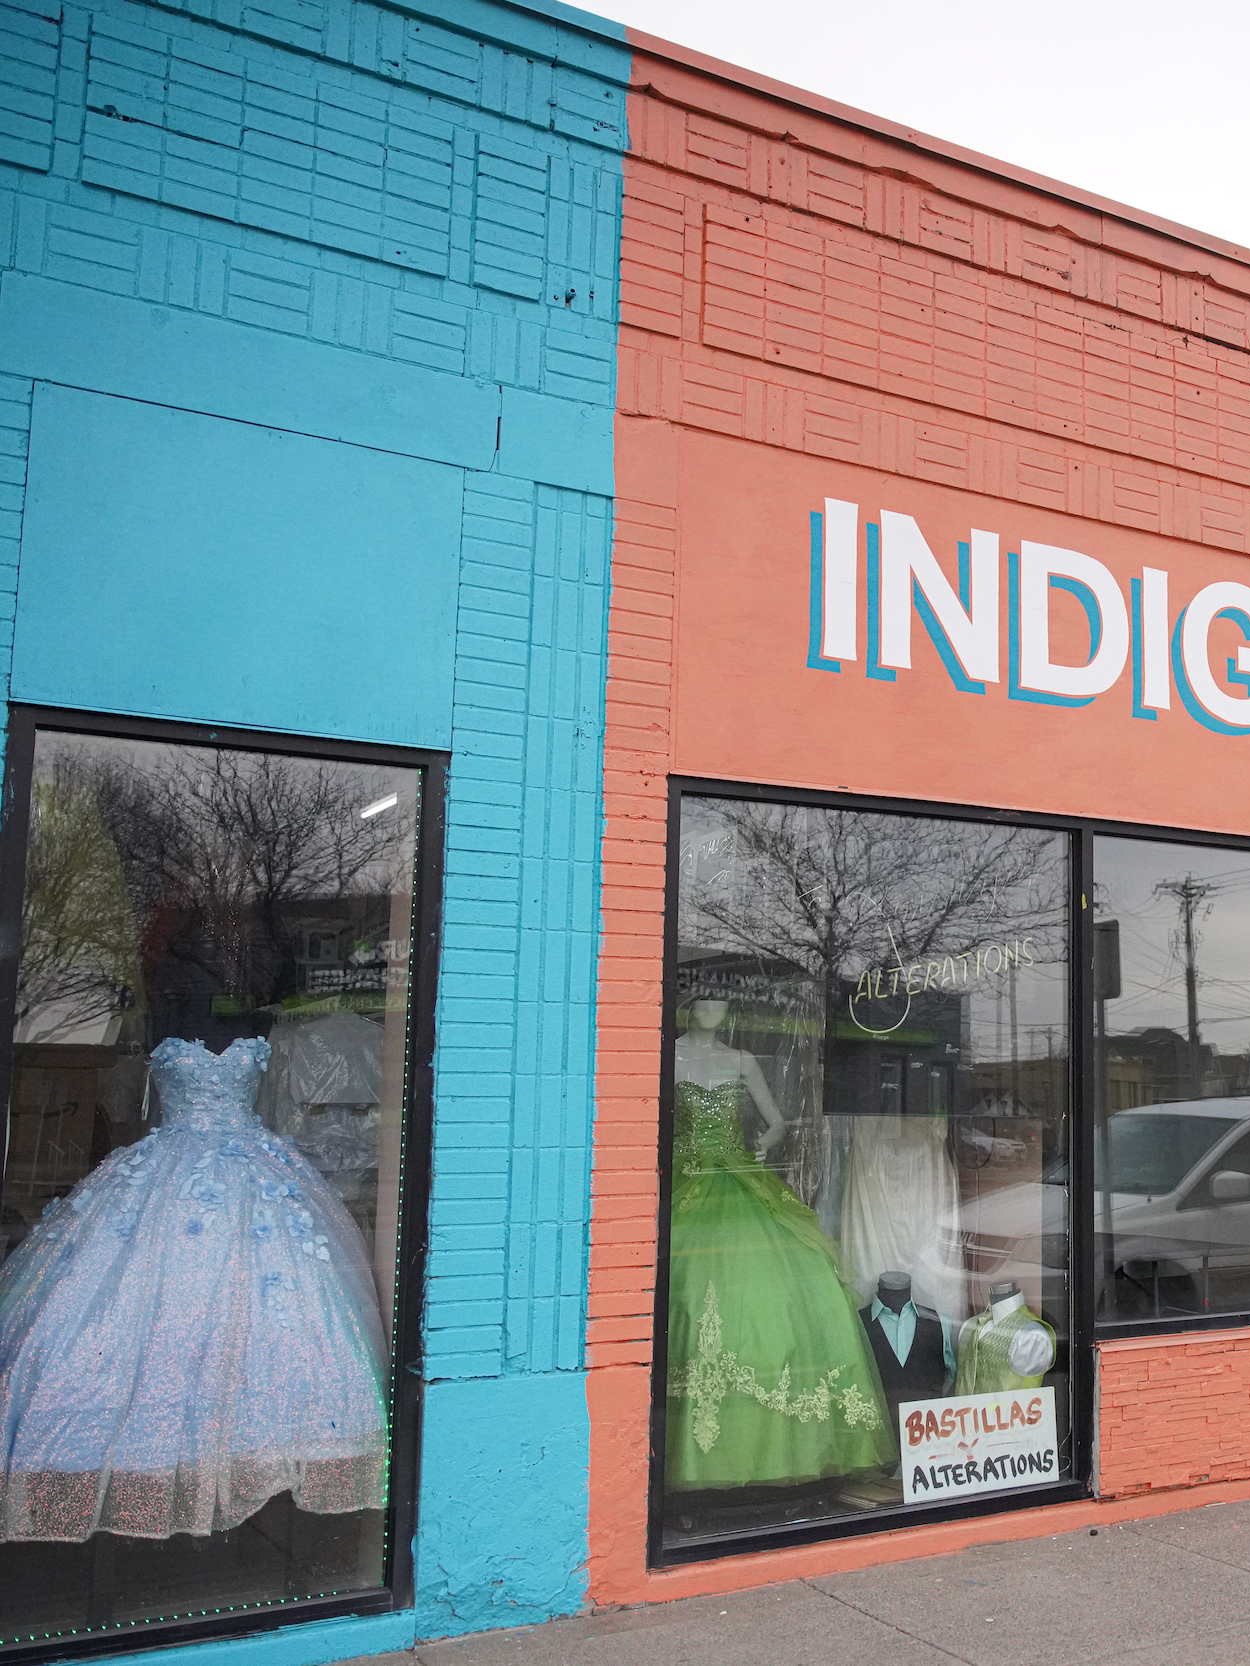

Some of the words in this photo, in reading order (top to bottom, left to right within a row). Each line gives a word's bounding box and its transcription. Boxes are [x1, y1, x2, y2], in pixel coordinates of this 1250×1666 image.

[855, 937, 1034, 1004] ALTERATIONS
[905, 1397, 1043, 1447] BASTILLAS
[912, 1449, 1054, 1494] ALTERATIONS
